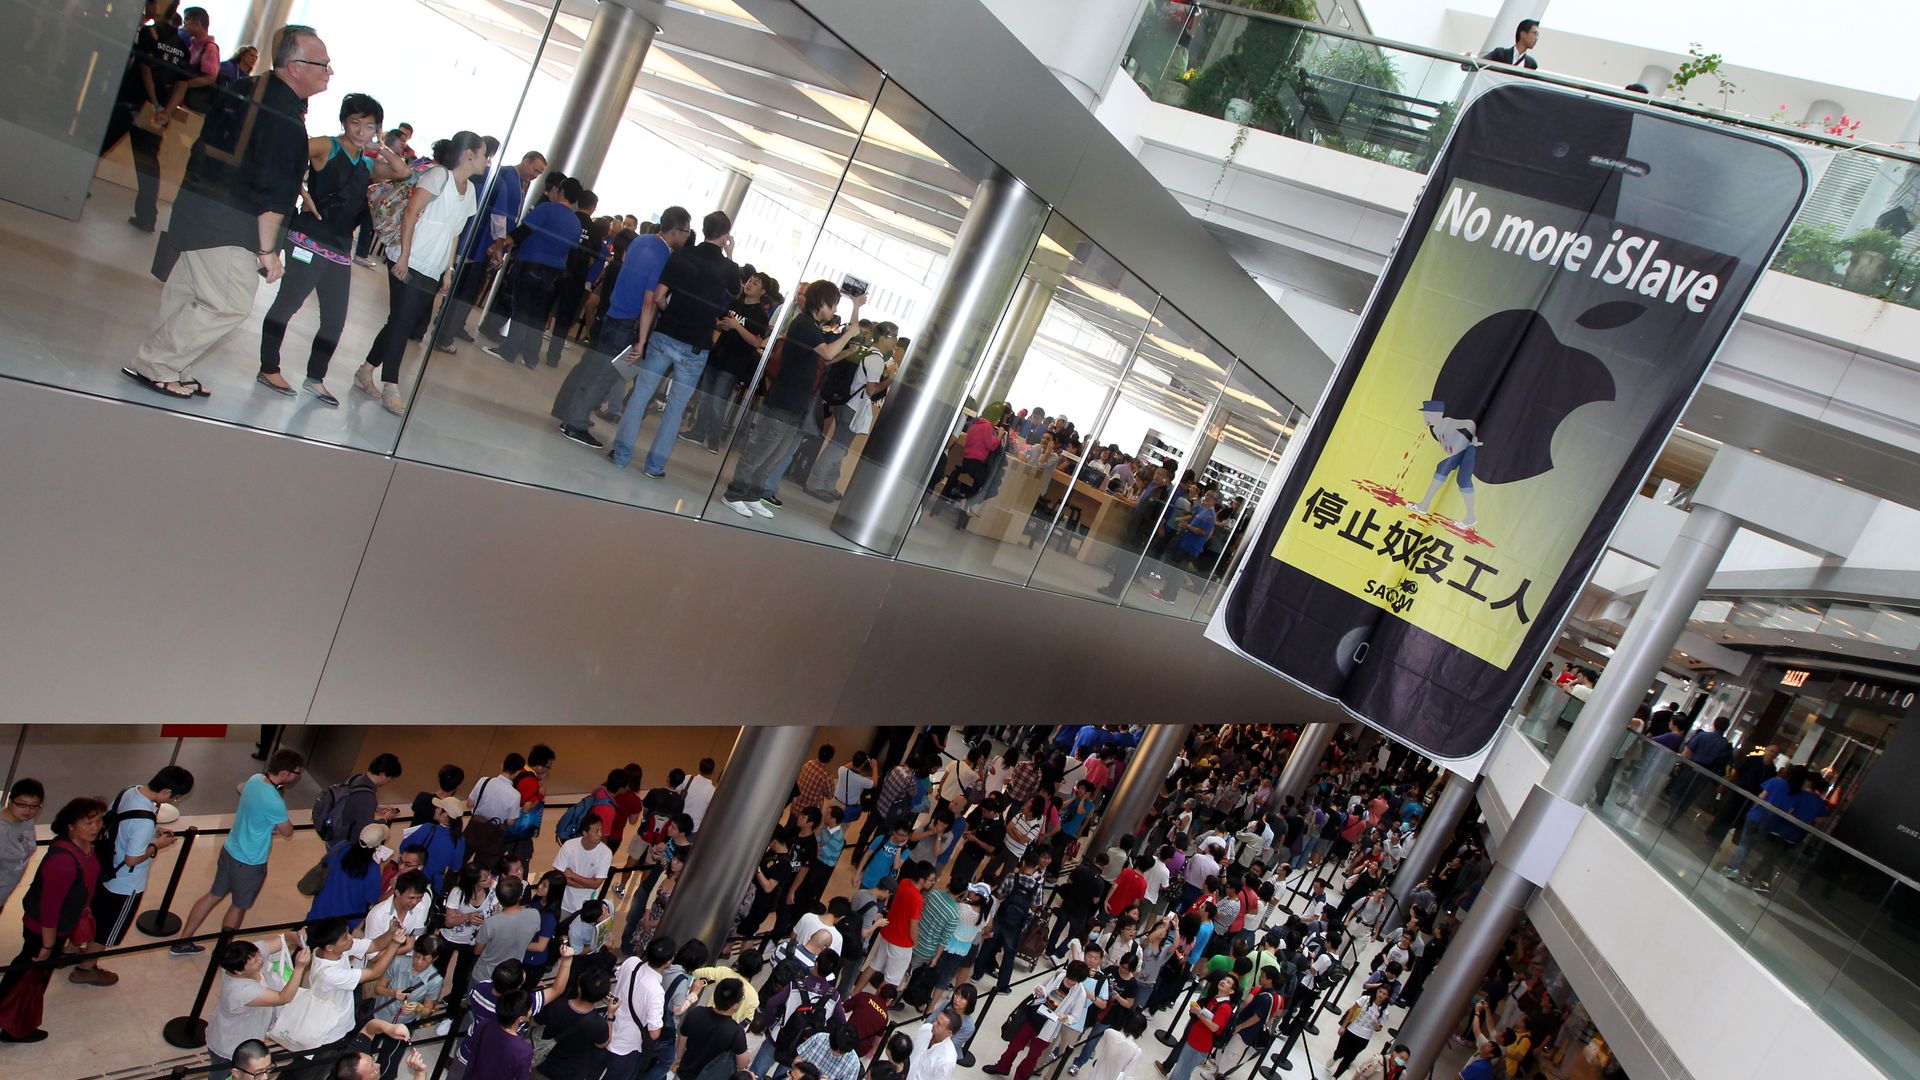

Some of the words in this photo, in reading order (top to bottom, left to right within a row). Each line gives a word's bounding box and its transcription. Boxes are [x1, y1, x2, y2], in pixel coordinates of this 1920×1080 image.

[1434, 186, 1491, 242] No
[1491, 214, 1593, 272] more
[1590, 228, 1719, 313] iSlave
[1301, 487, 1532, 625] 停止奴役工人
[868, 998, 888, 1019] NIXON
